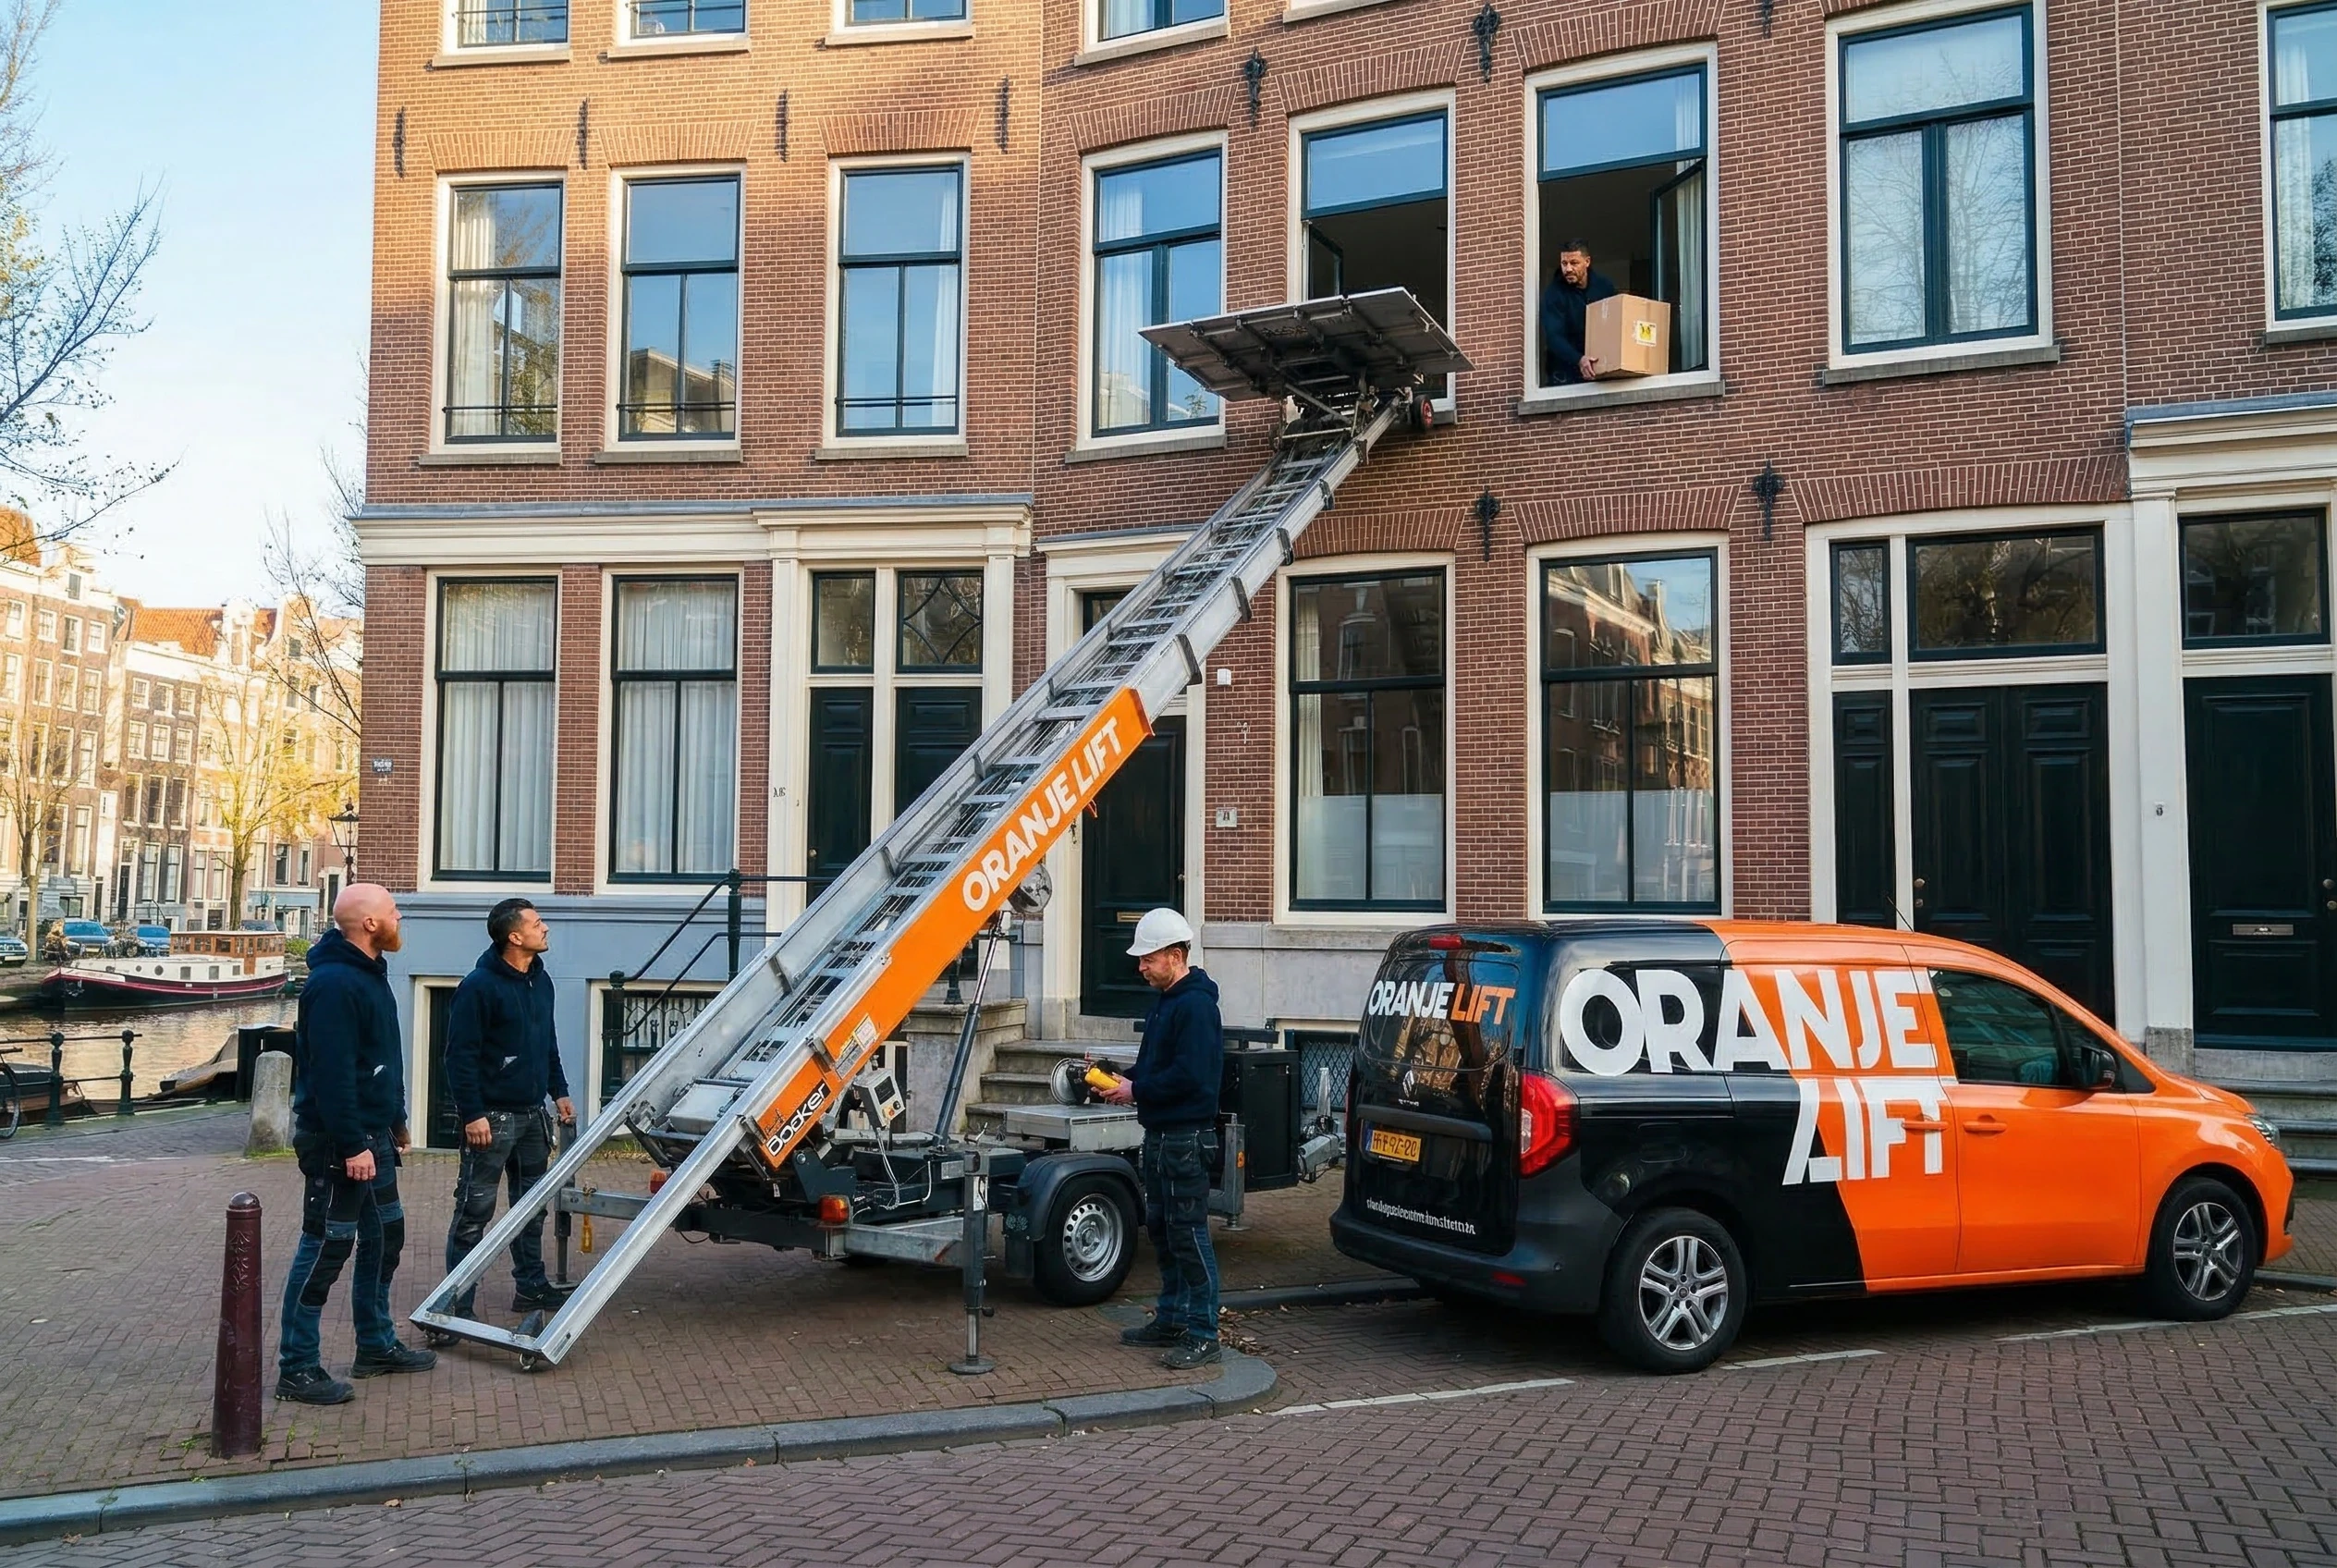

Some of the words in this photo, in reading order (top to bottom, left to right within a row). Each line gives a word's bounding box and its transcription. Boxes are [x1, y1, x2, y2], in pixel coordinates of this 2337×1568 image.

[962, 770, 1078, 913] ORANJE
[1071, 716, 1122, 797] LIFT
[1368, 980, 1455, 1020] ORANJE
[1450, 983, 1516, 1025] LIFT
[1560, 968, 1939, 1076] ORANJE
[1781, 1077, 1949, 1185] LIFT
